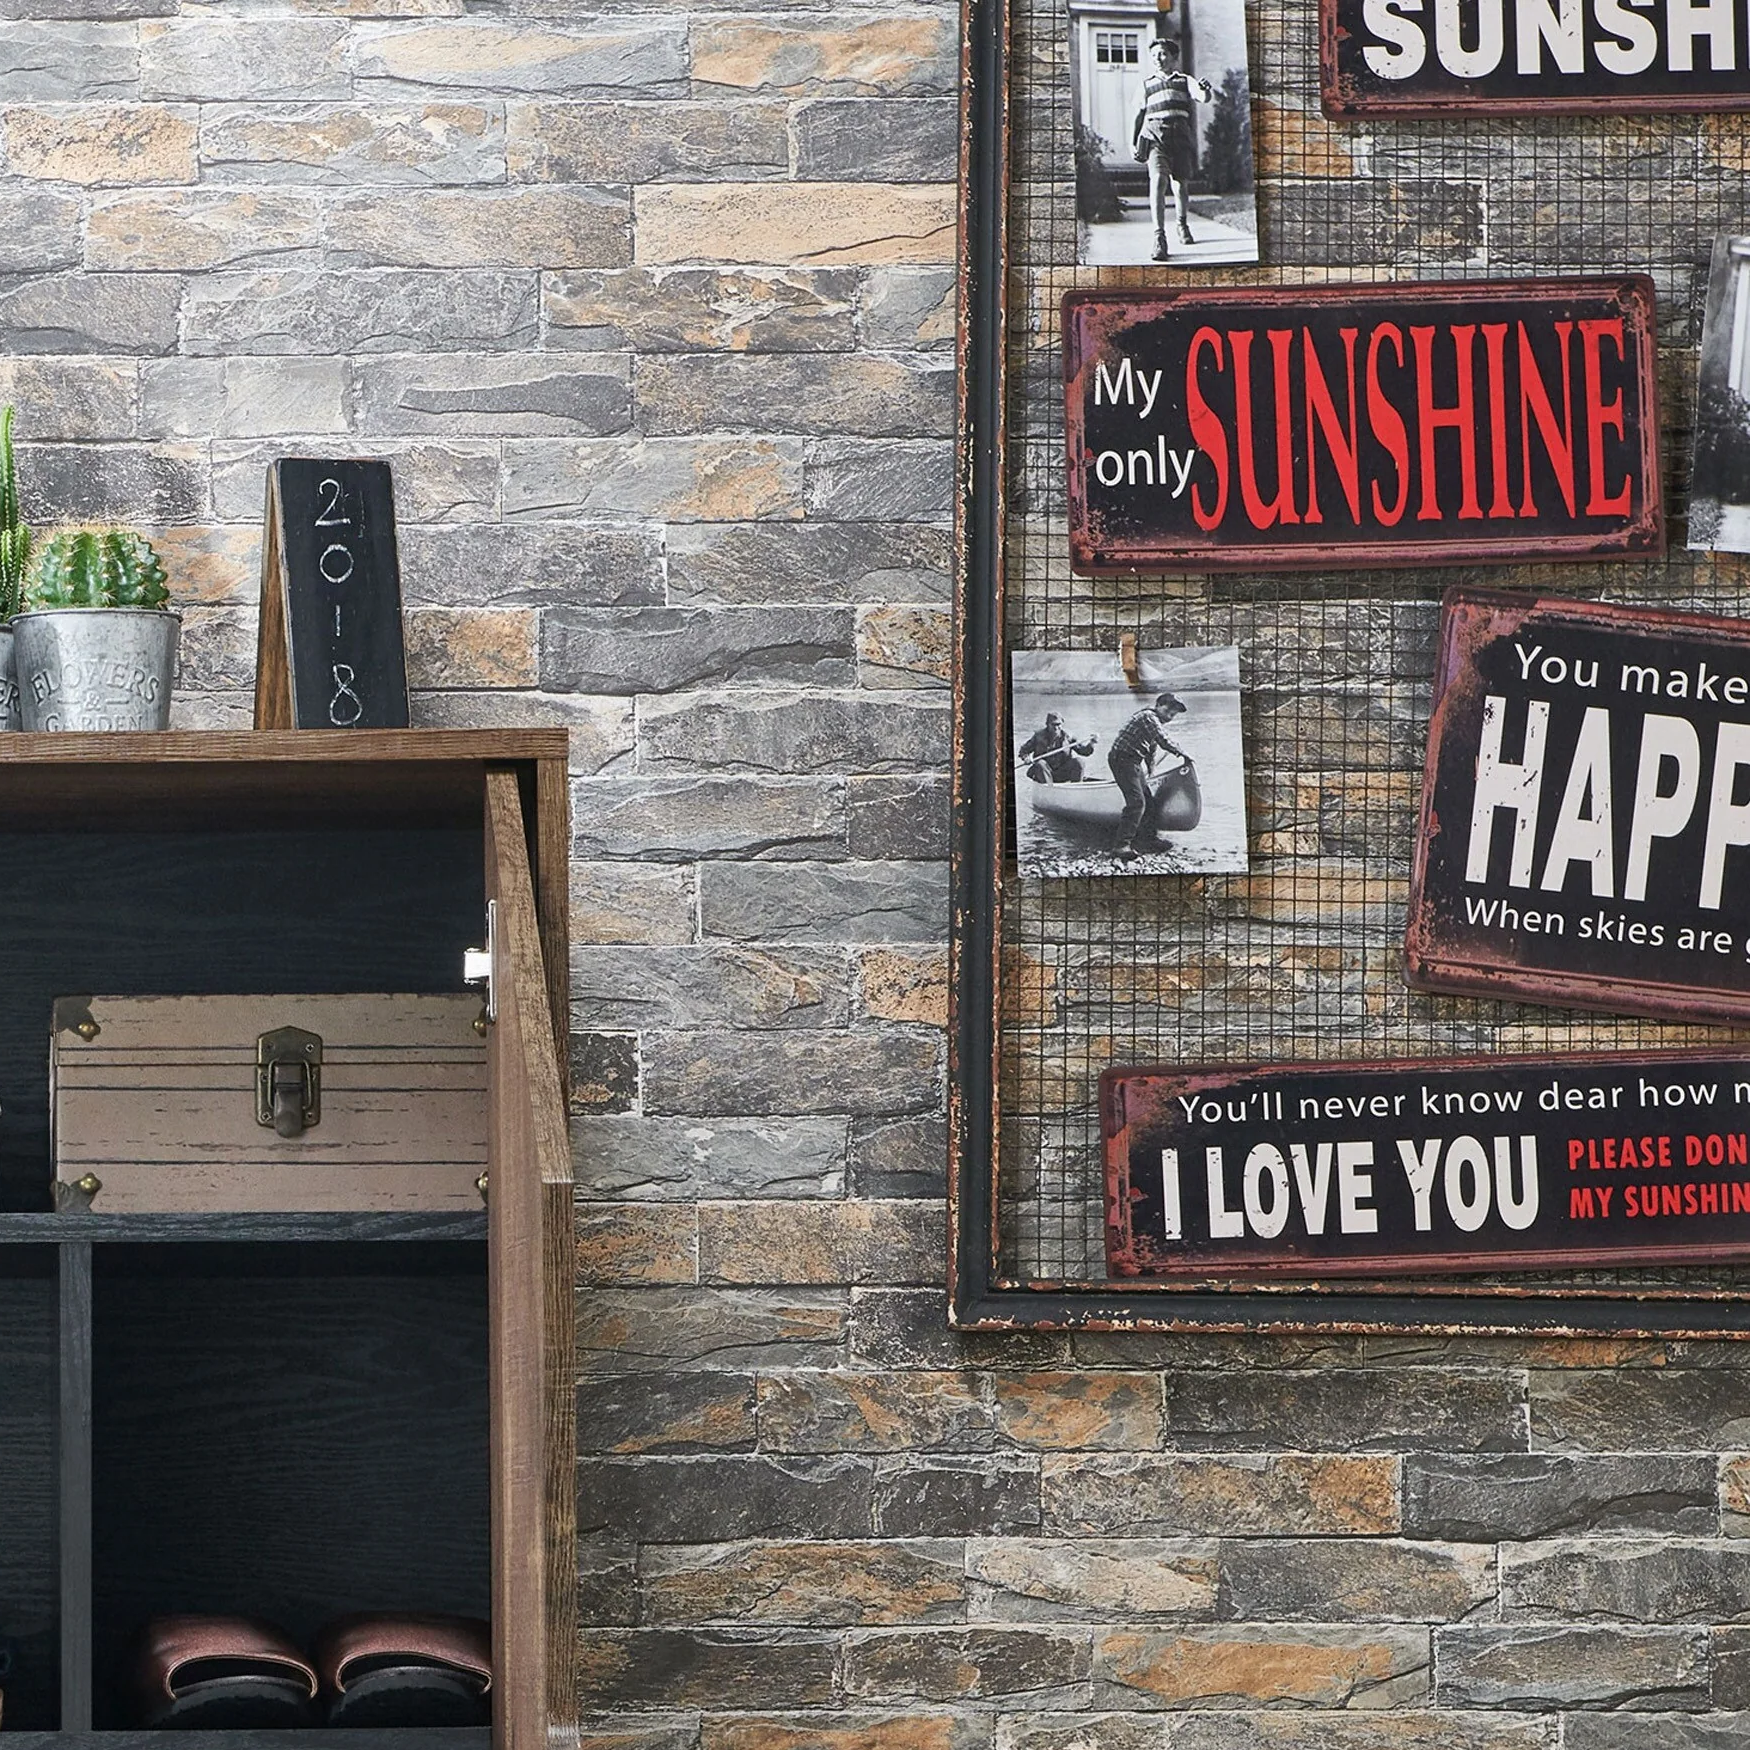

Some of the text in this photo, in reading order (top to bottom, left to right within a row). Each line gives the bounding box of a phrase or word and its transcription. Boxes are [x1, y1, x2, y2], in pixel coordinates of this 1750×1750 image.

[1362, 0, 1750, 80] SUNSH
[1094, 357, 1163, 419] My
[1186, 317, 1631, 531] SUNSHINE
[1095, 435, 1195, 499] only
[31, 658, 160, 705] FLOWERS
[1514, 643, 1749, 704] You make
[45, 712, 143, 732] GARDEN
[1465, 695, 1750, 910] HAPP
[1465, 896, 1565, 935] When
[1578, 911, 1665, 946] skies
[1677, 927, 1732, 953] are
[1179, 1091, 1282, 1123] You'll
[1300, 1094, 1405, 1119] never
[1421, 1086, 1523, 1115] know
[1538, 1081, 1623, 1110] dear
[1639, 1078, 1718, 1107] how
[1568, 1133, 1748, 1170] PLEASE DON
[1161, 1135, 1540, 1240] I LOVE YOU
[1570, 1182, 1750, 1219] MY SUNSHIN
